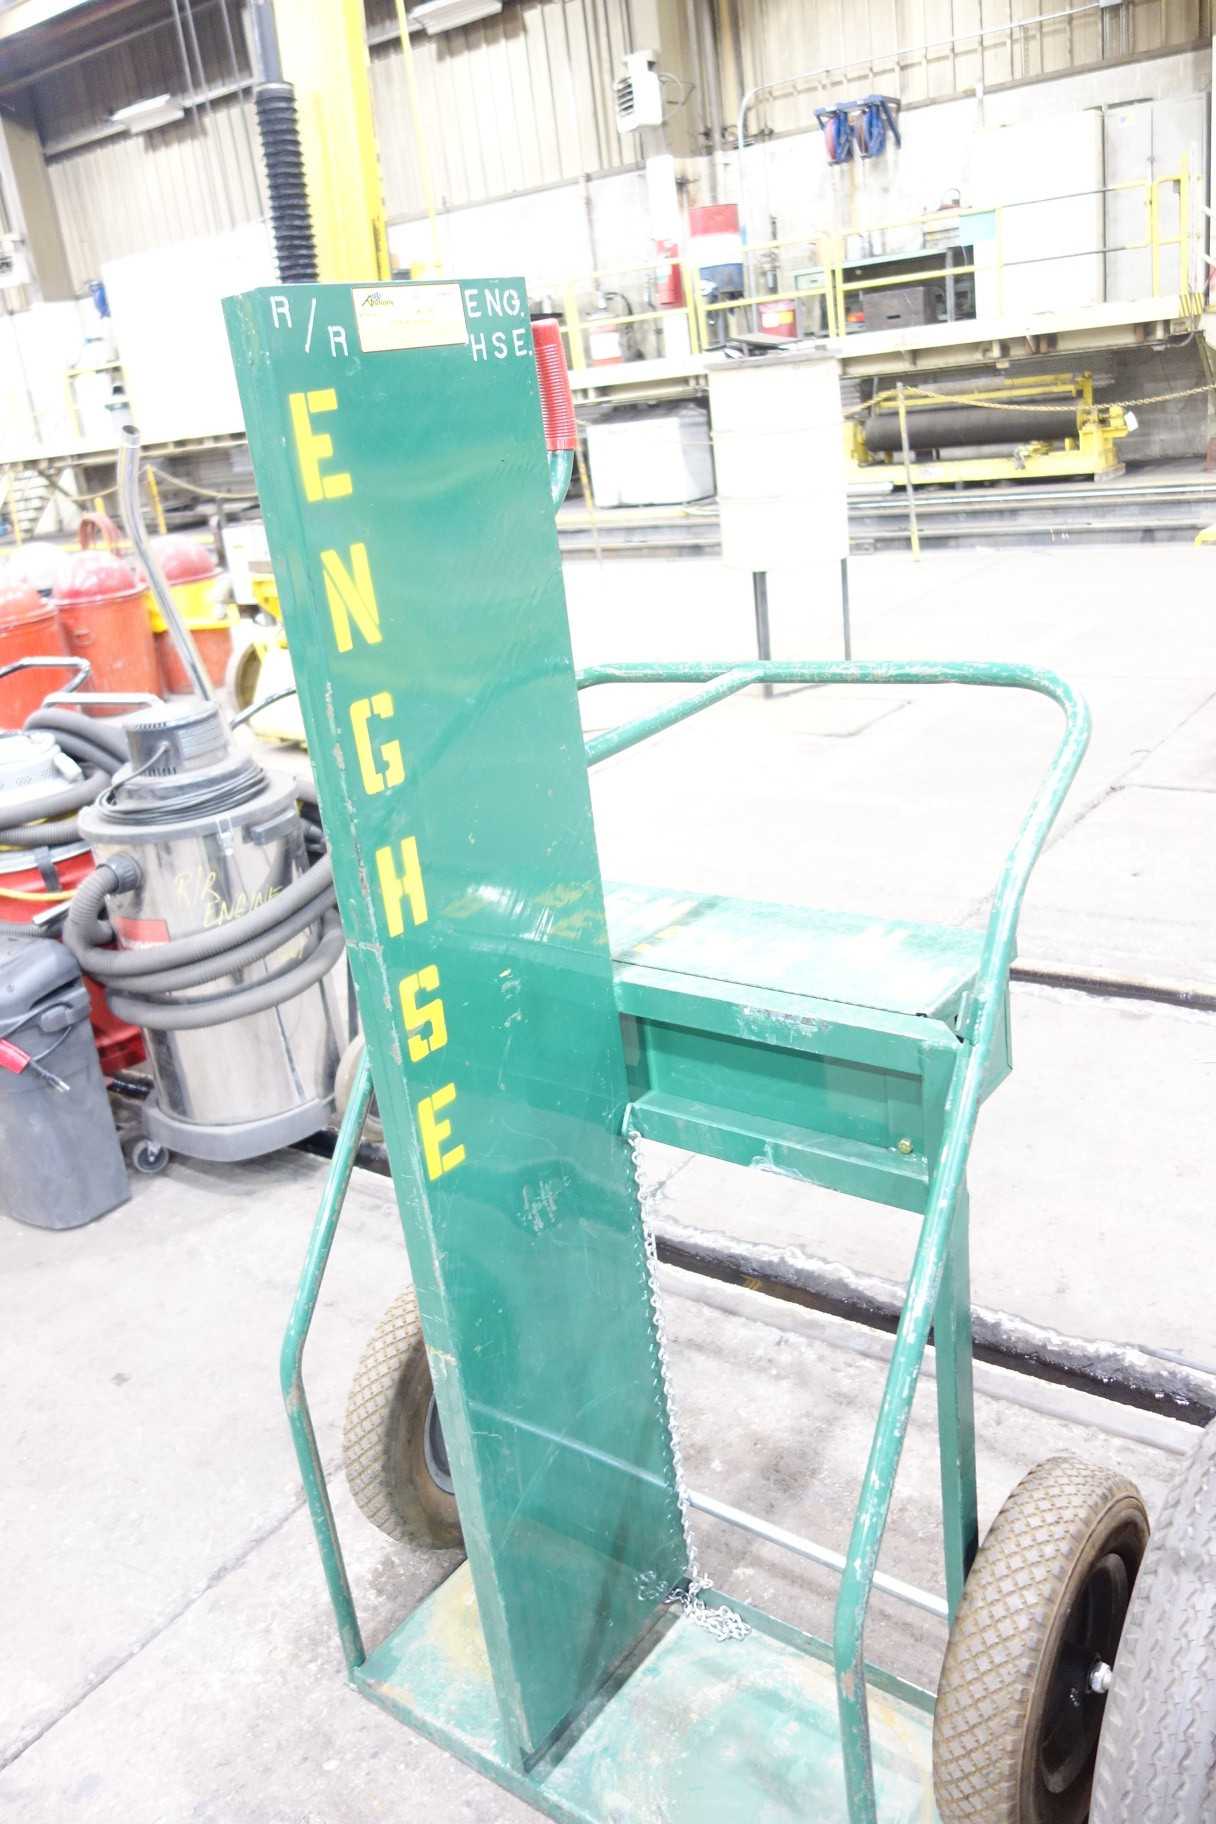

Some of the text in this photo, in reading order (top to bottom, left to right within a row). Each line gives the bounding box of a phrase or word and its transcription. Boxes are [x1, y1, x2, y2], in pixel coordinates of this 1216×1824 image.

[270, 288, 525, 357] R/R ENG.
[470, 328, 533, 362] HSE.
